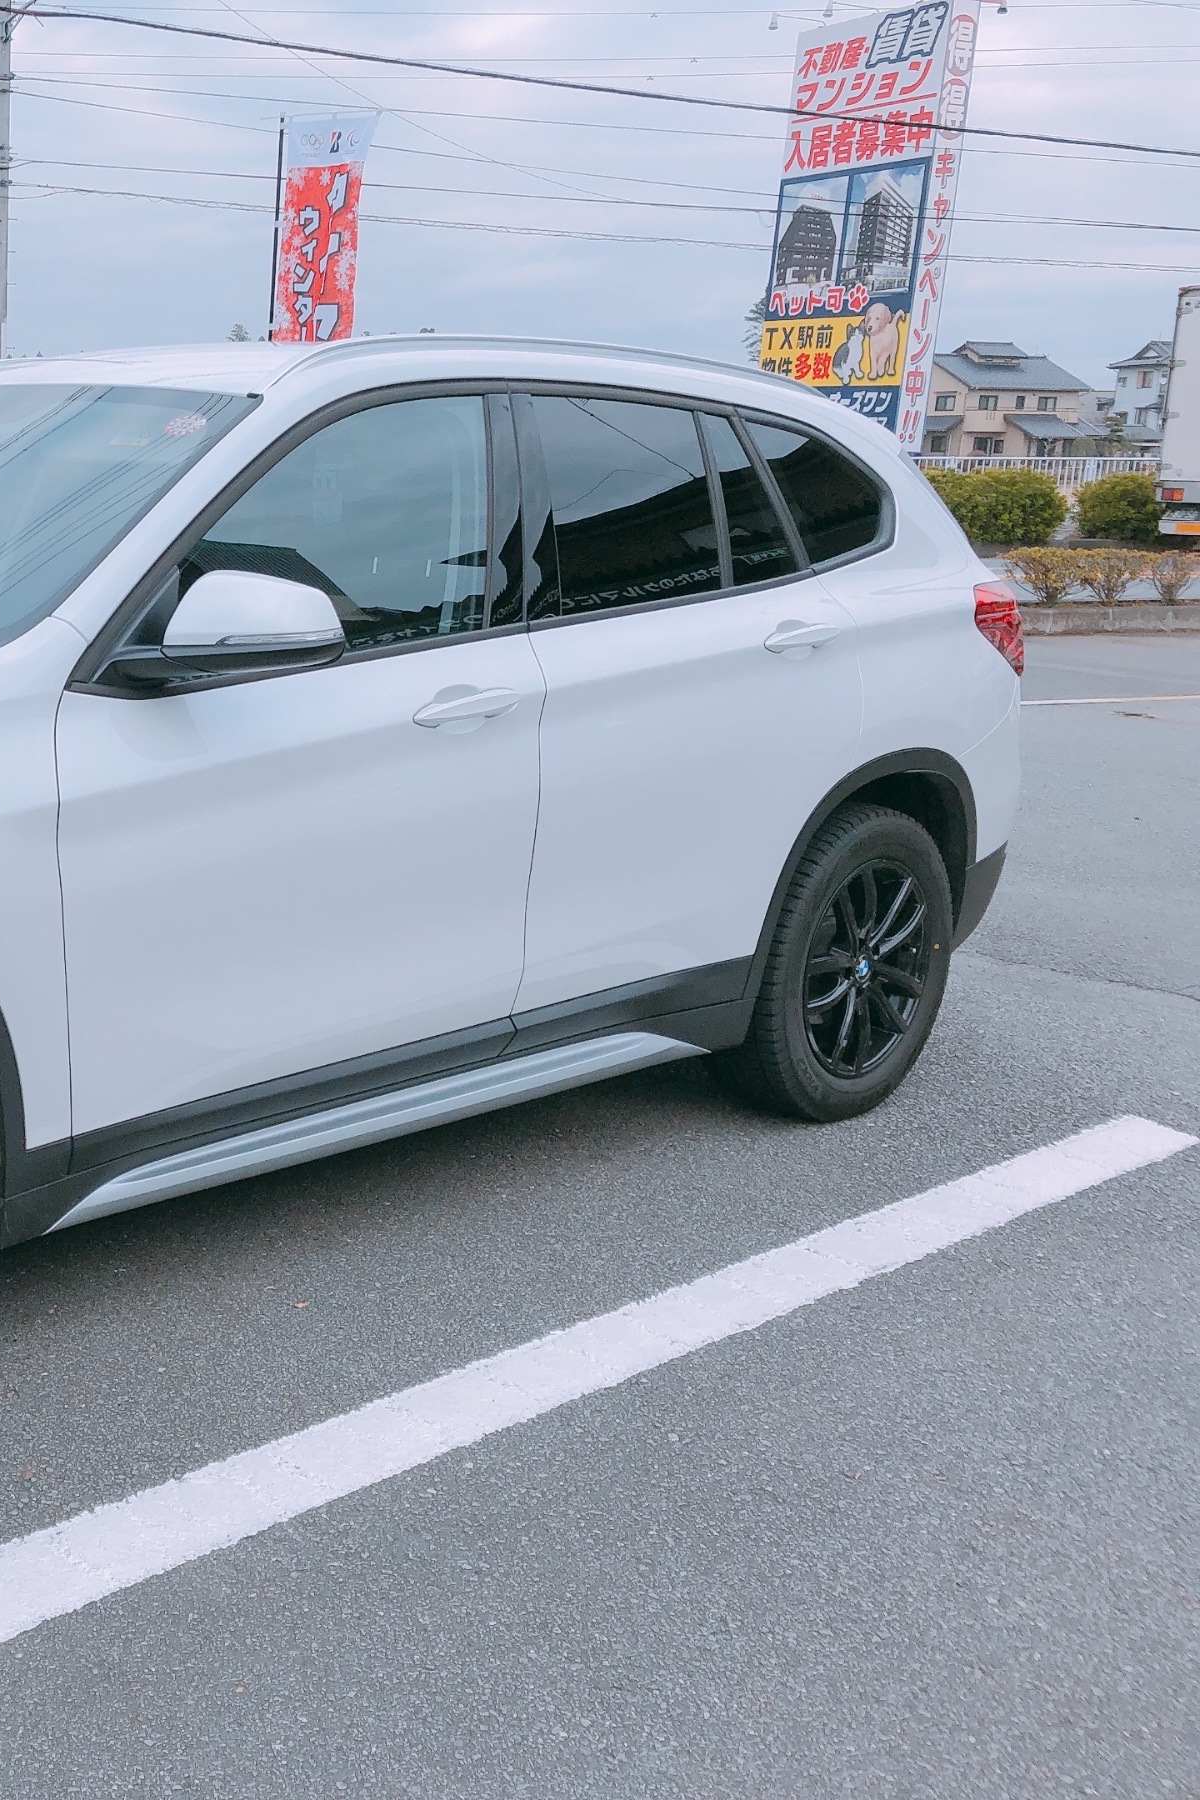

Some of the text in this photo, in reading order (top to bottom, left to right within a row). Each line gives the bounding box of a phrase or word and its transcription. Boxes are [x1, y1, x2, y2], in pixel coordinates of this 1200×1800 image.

[796, 58, 934, 112] マンション
[784, 105, 935, 173] 入居者募集中
[769, 287, 845, 316] ペット可
[765, 323, 834, 351] TX駅前
[761, 352, 832, 381] 物件多数
